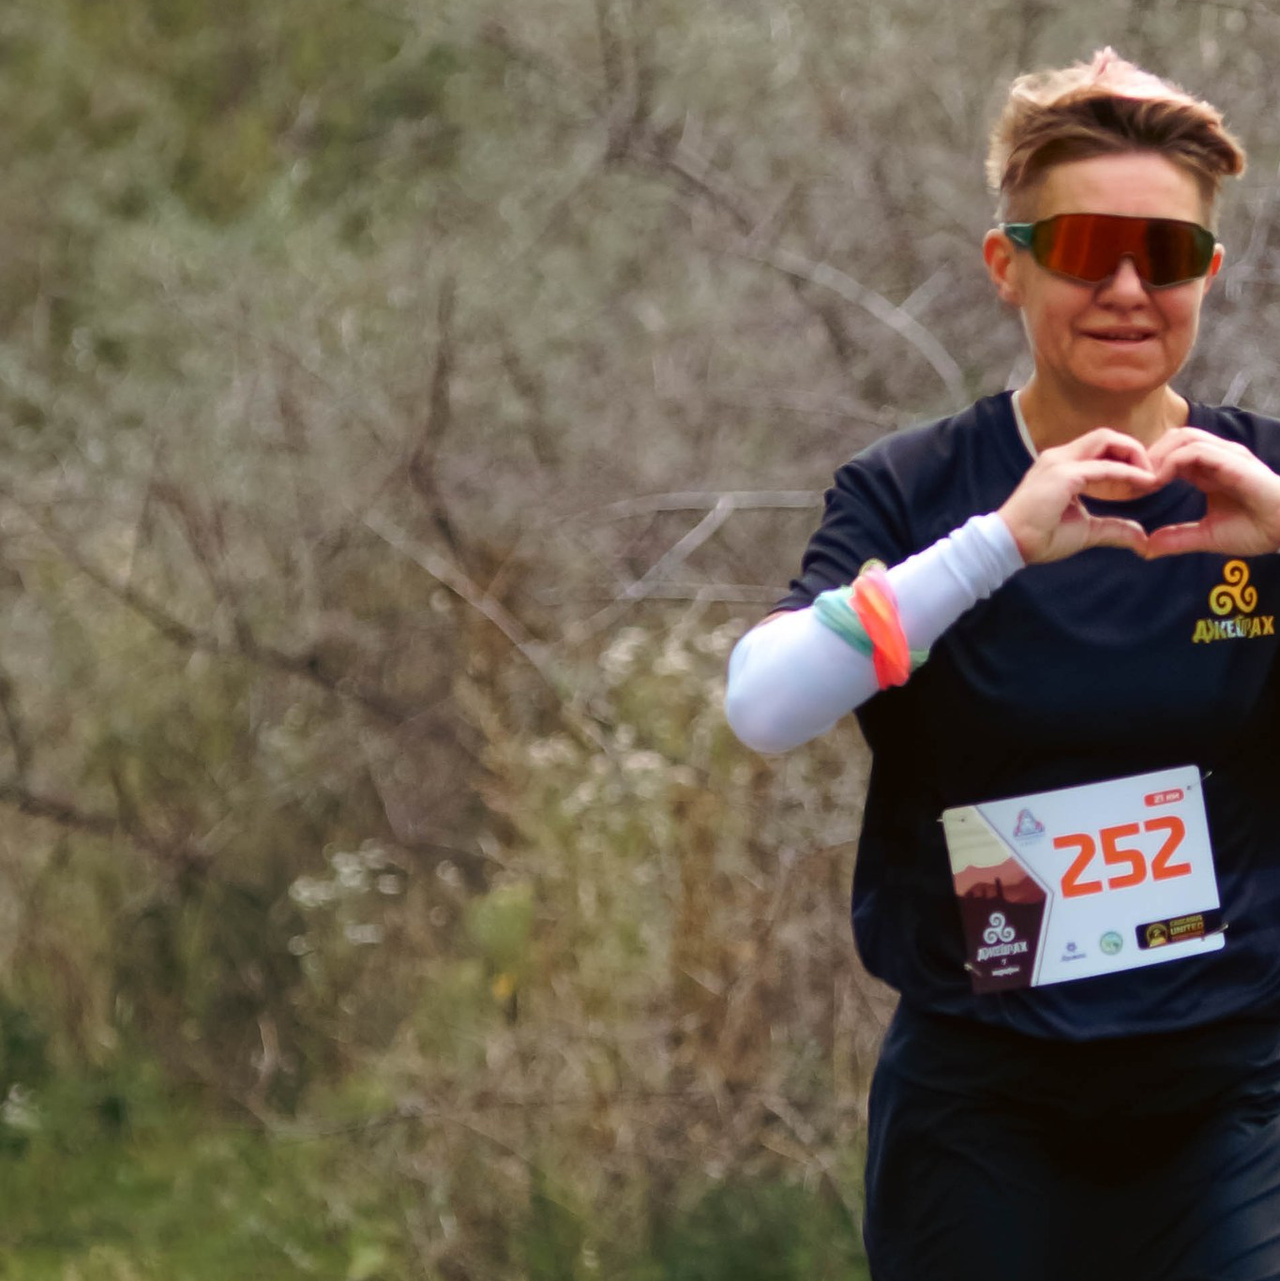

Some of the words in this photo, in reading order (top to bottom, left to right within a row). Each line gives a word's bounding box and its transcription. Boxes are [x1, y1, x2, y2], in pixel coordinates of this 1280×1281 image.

[1192, 615, 1275, 643] ДЖЕЙРАХ
[1052, 815, 1191, 898] 252
[1170, 922, 1204, 935] UNITED
